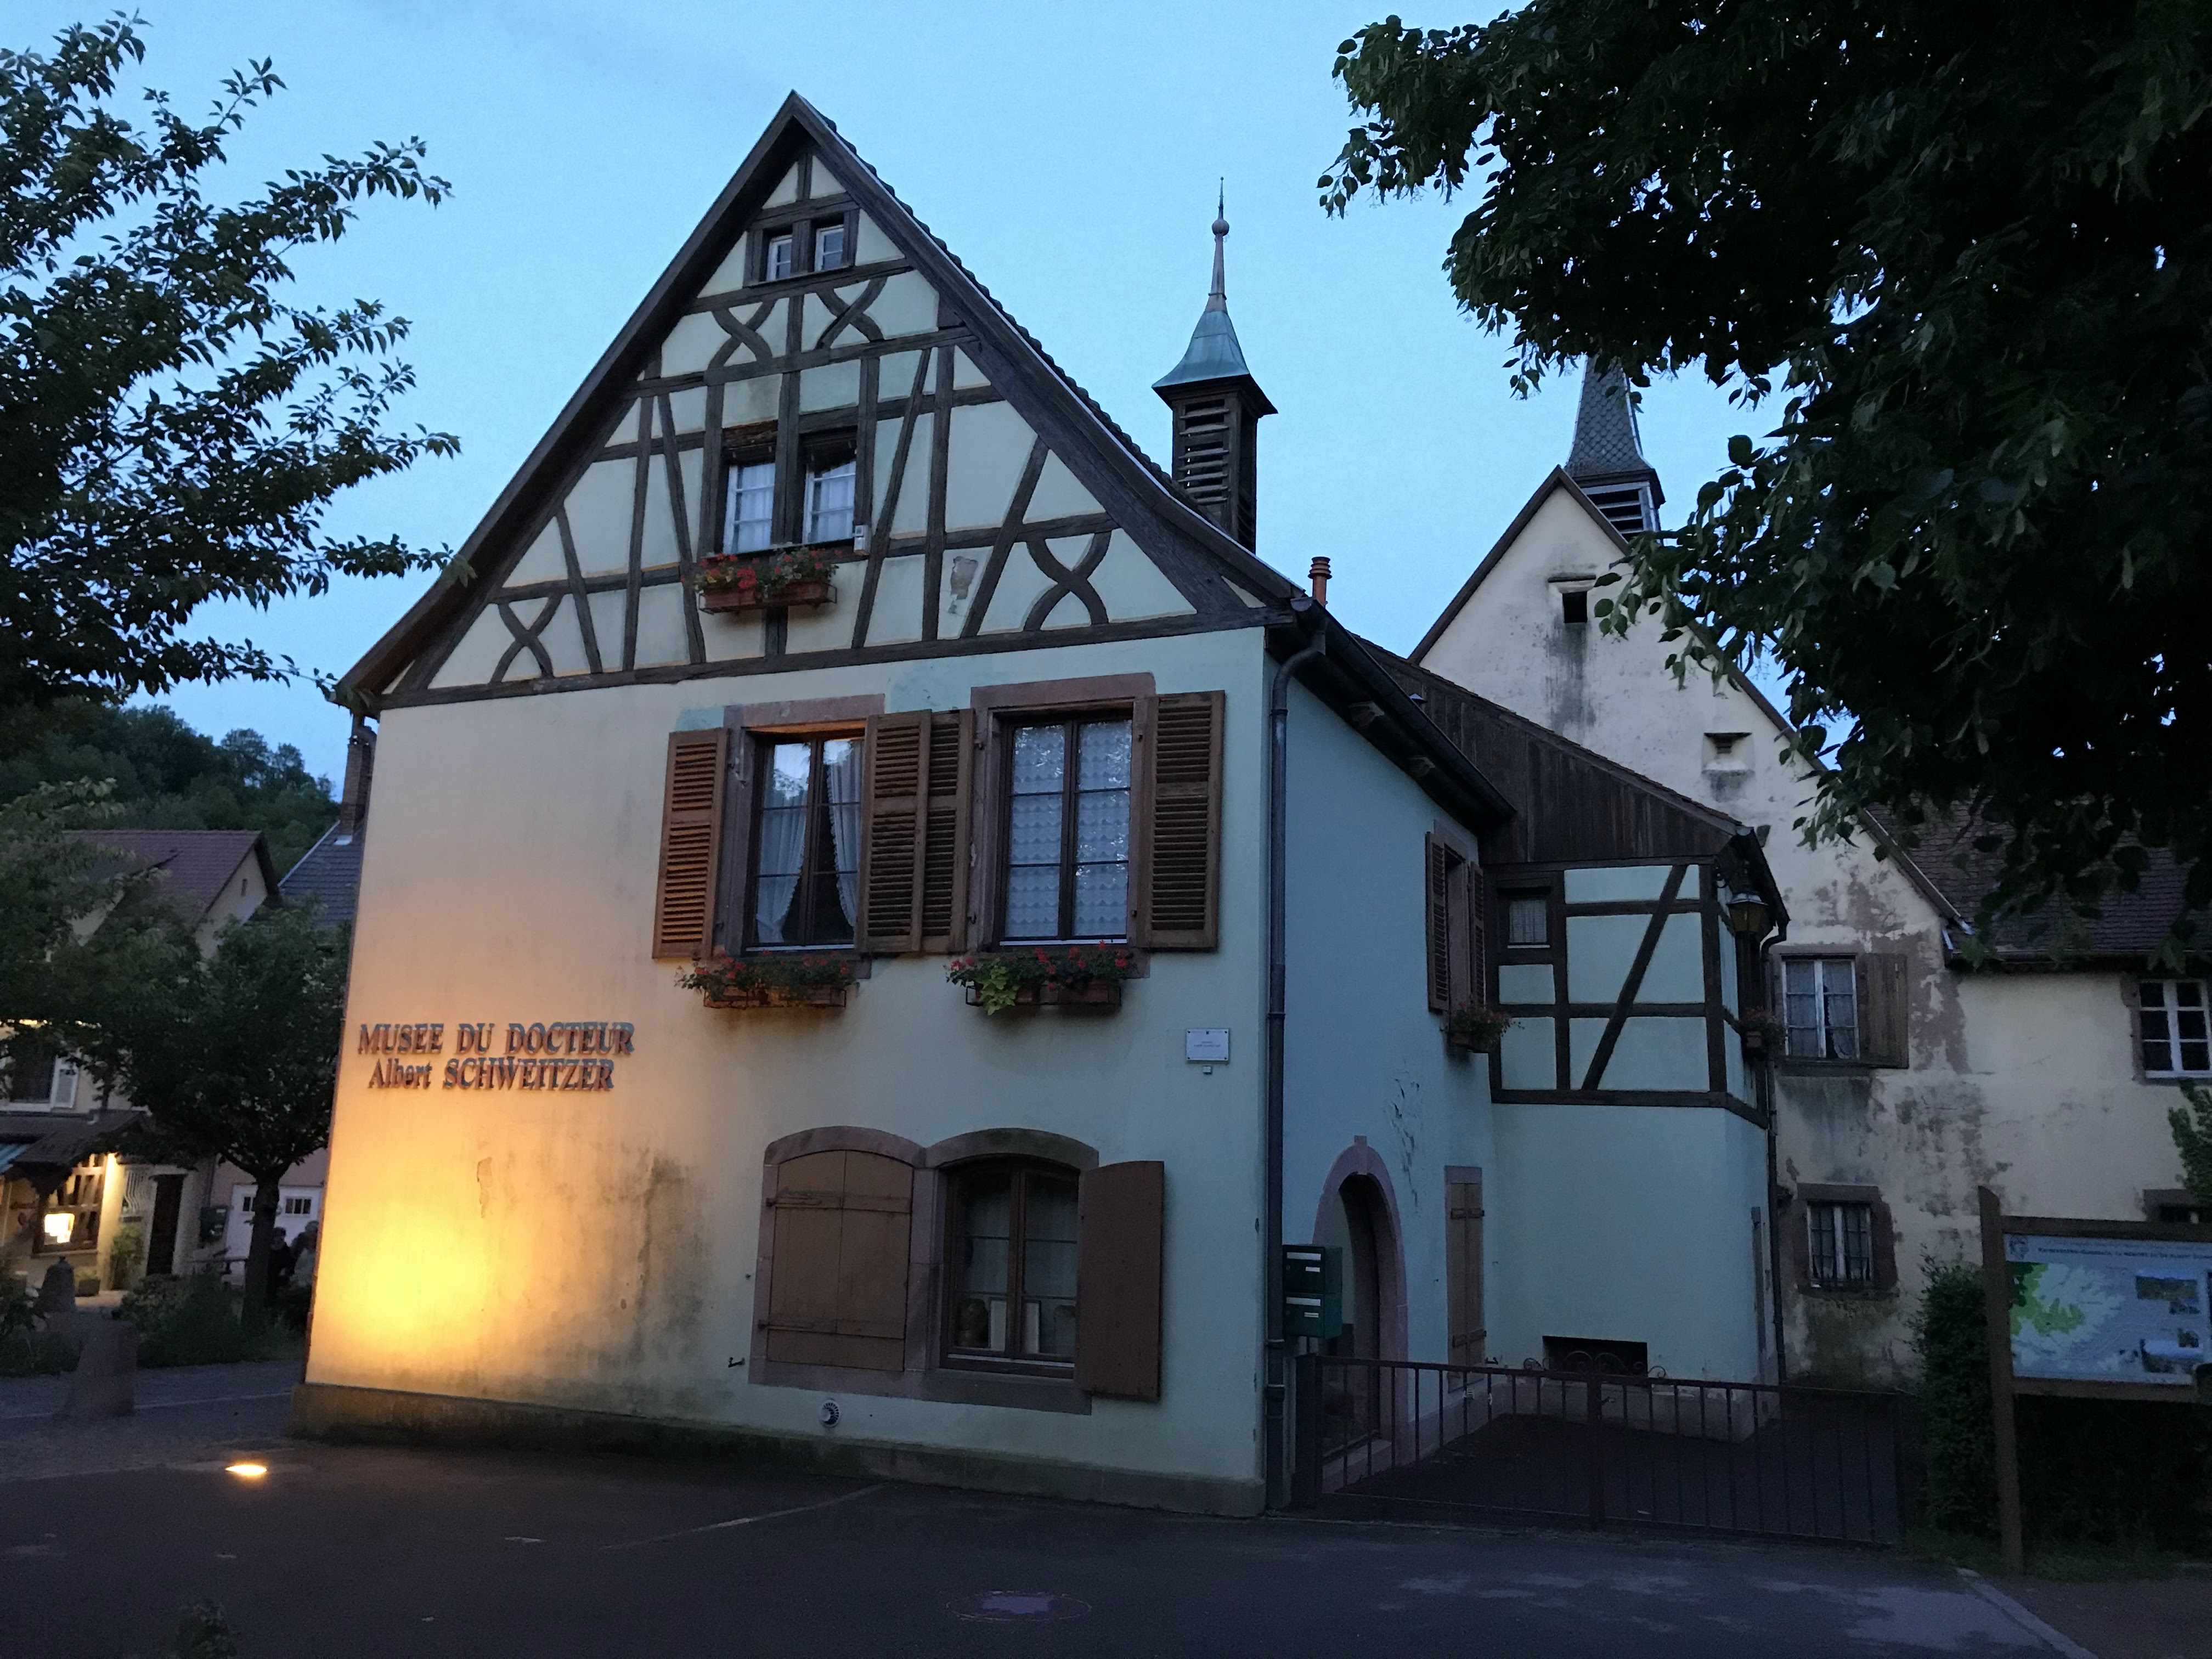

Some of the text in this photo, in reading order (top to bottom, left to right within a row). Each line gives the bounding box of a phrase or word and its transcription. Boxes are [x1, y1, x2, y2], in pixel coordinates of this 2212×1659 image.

[358, 1022, 635, 1055] MUSEE DU DOCTEUR
[368, 1056, 614, 1091] Albert SCHWEITZER
